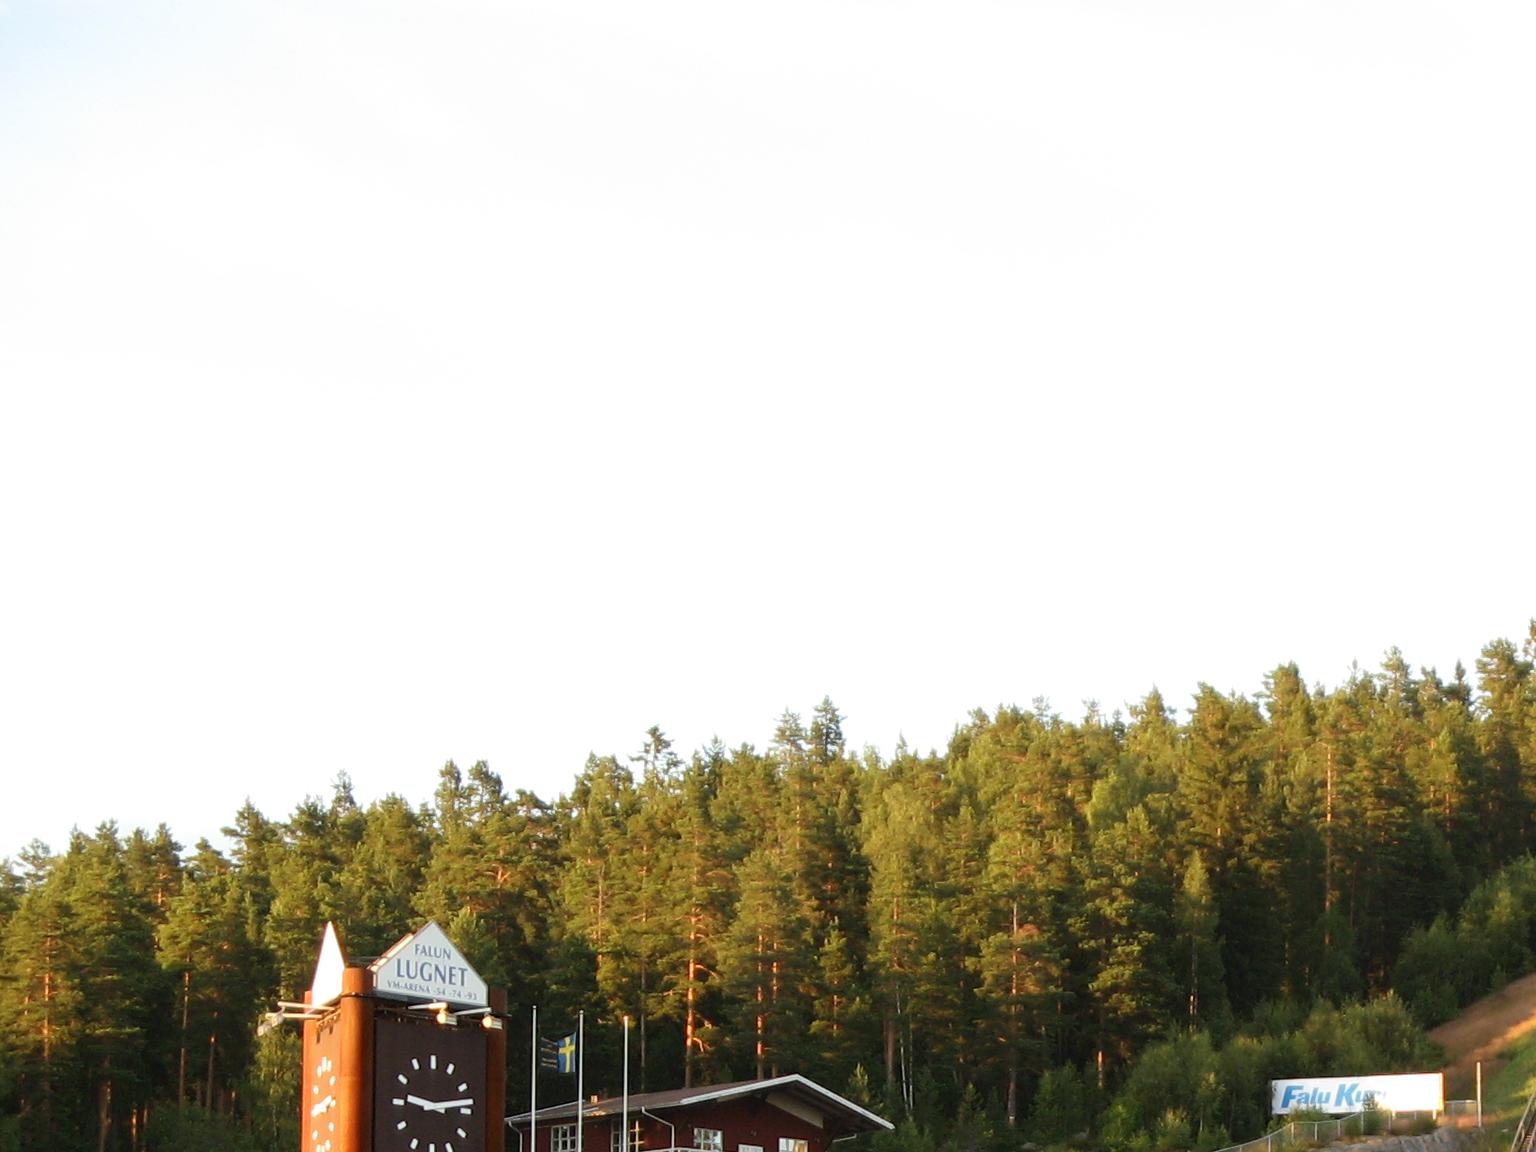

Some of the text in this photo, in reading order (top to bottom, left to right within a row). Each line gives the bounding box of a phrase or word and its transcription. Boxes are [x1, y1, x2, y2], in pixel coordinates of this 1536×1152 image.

[415, 943, 451, 959] FALUN
[396, 959, 468, 986] LUGNET
[387, 980, 431, 994] VM-ARENA
[1281, 1085, 1331, 1109] Falu
